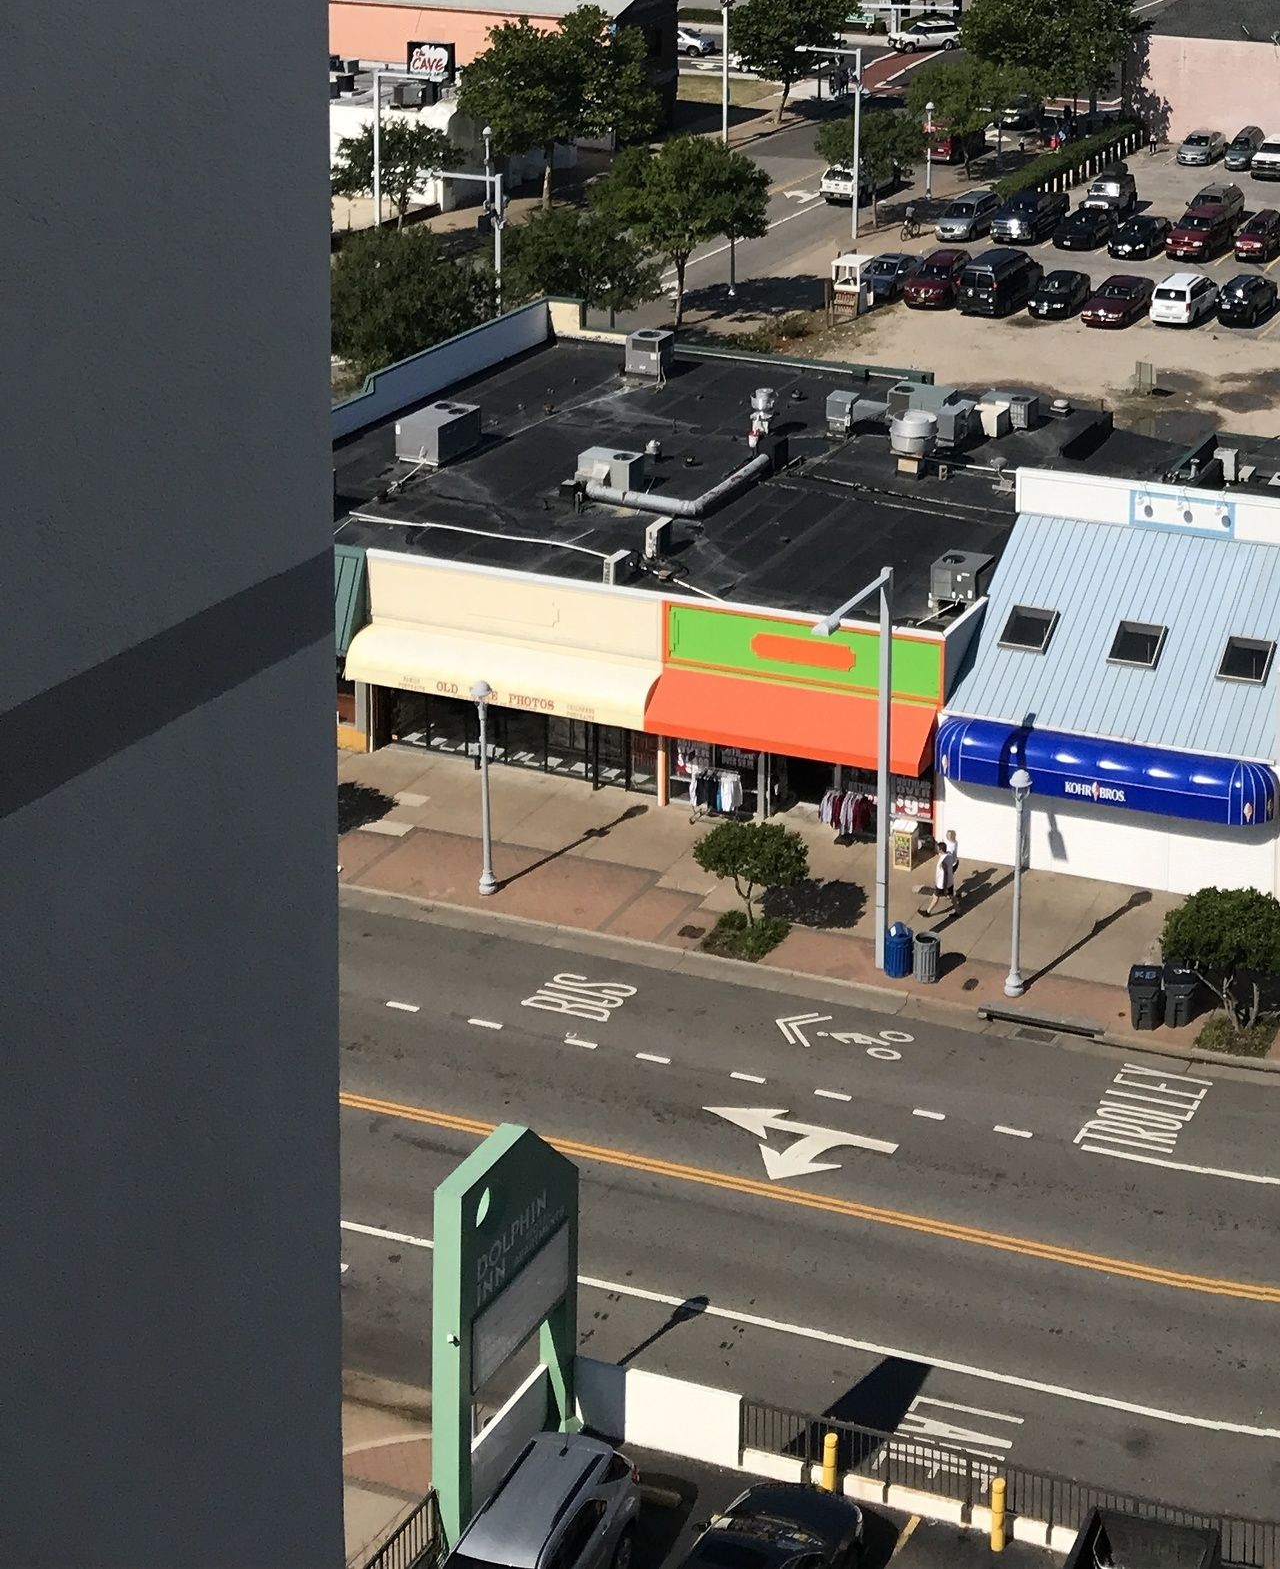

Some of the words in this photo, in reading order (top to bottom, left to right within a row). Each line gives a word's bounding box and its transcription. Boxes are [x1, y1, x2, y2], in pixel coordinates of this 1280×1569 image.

[412, 57, 444, 71] CAVE
[436, 681, 459, 694] OLD
[508, 693, 555, 711] PHOTOS
[1064, 781, 1092, 797] KOHR
[1099, 786, 1127, 802] BROS.
[521, 972, 637, 1022] BUS
[1073, 1062, 1214, 1154] TROLLEY
[476, 1188, 548, 1279] DOLPHIN
[476, 1256, 506, 1308] INN
